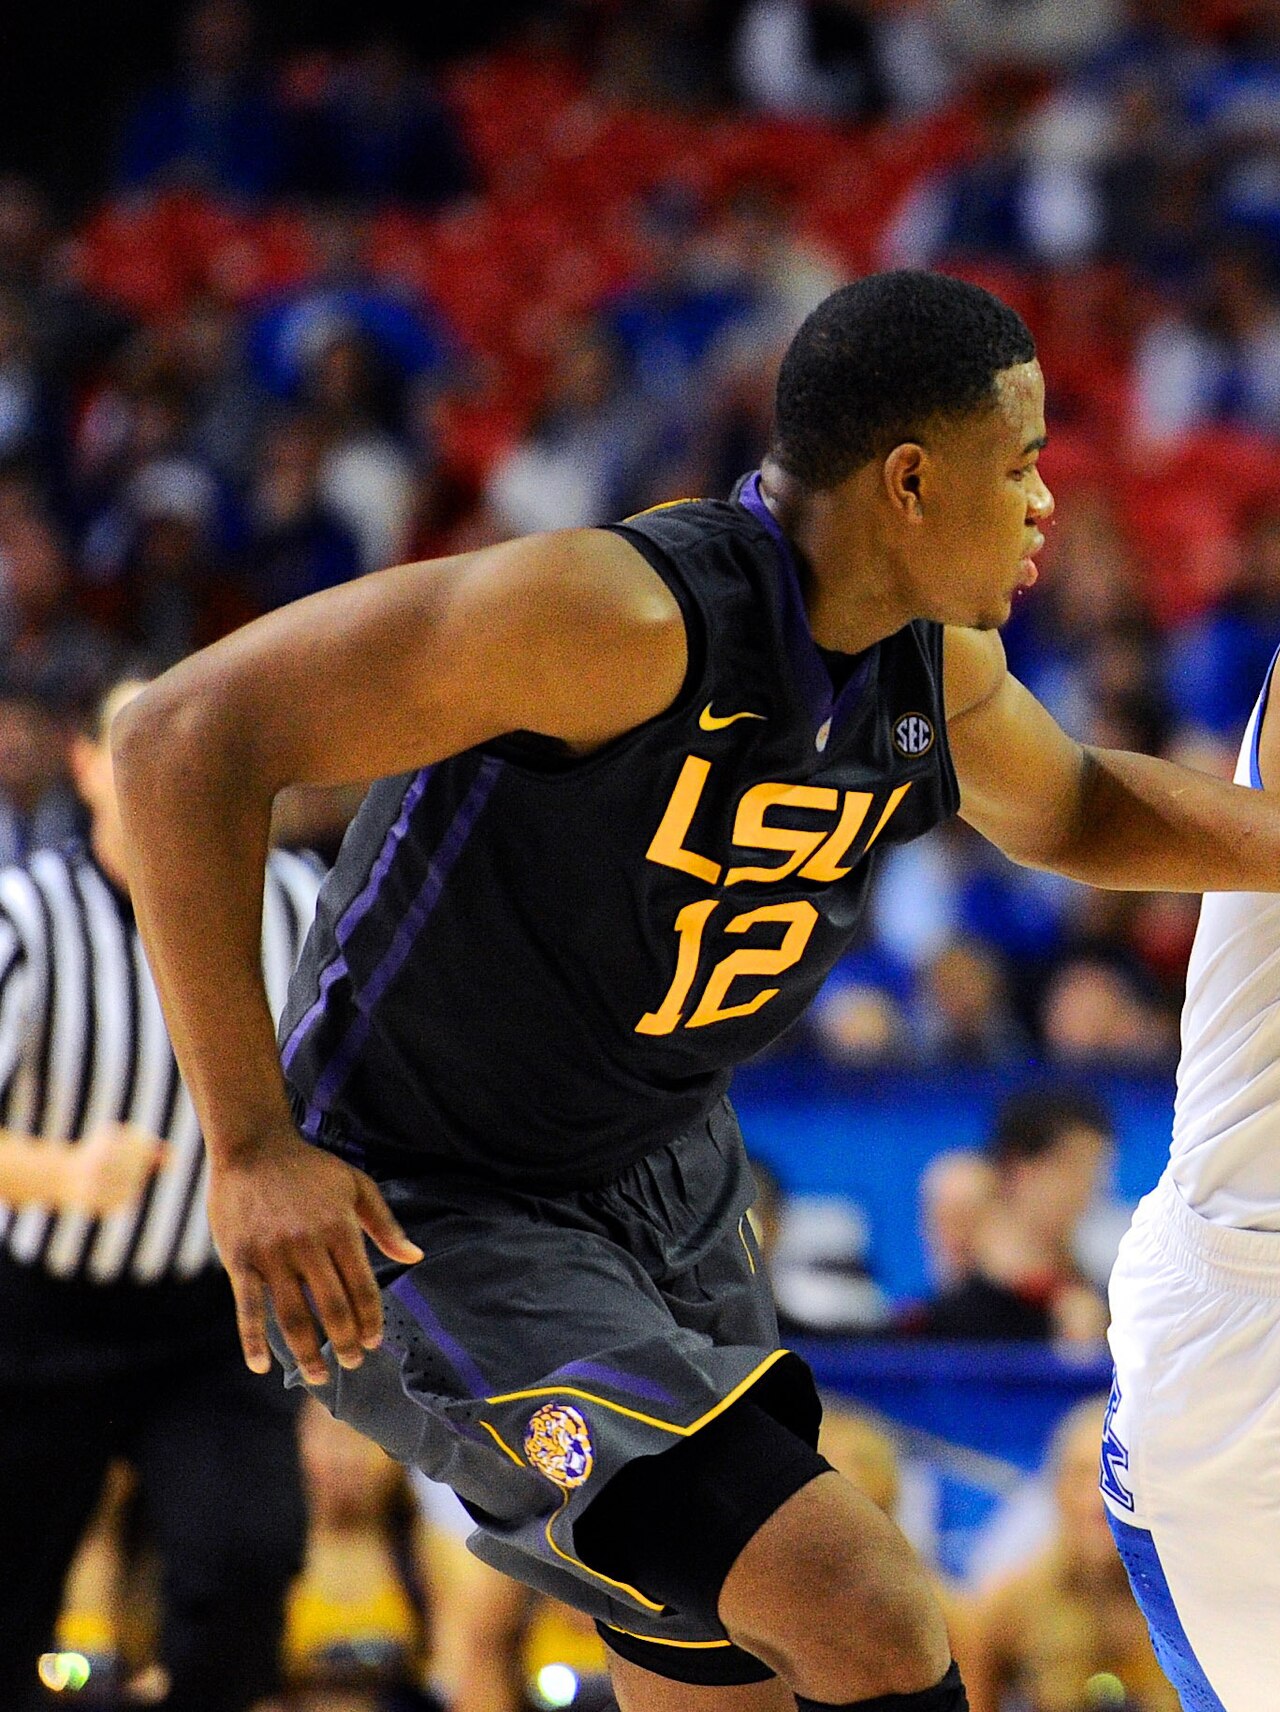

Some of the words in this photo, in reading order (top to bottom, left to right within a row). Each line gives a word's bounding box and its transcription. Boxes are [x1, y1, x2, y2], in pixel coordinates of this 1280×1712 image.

[895, 715, 930, 753] SEC
[644, 754, 913, 887] LSU
[634, 899, 819, 1036] 12
